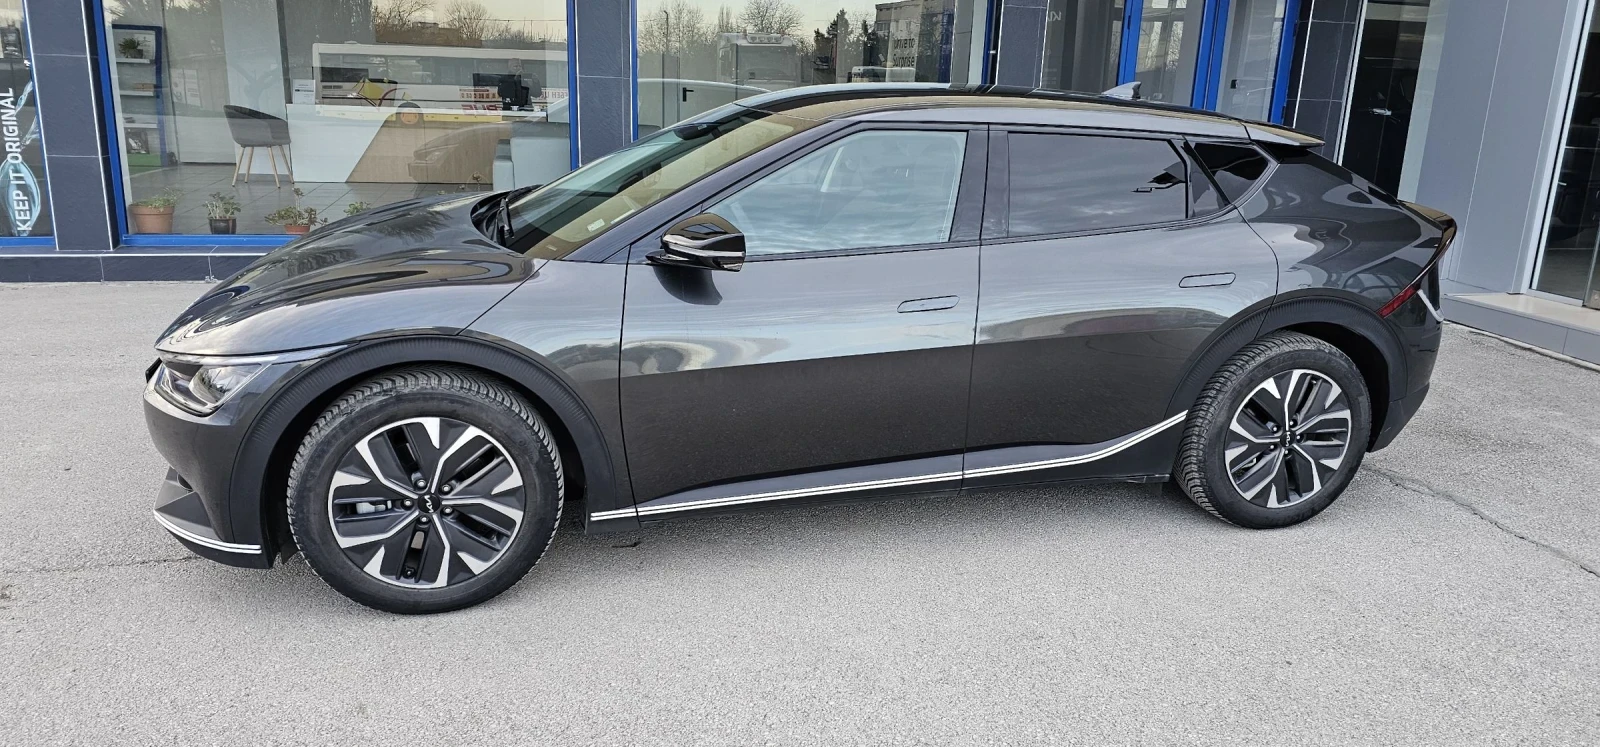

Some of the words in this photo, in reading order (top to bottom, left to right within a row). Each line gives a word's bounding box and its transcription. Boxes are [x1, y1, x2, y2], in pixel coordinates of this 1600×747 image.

[0, 87, 23, 164] ORIGINAL
[9, 169, 26, 185] IT
[12, 190, 33, 231] KEEP
